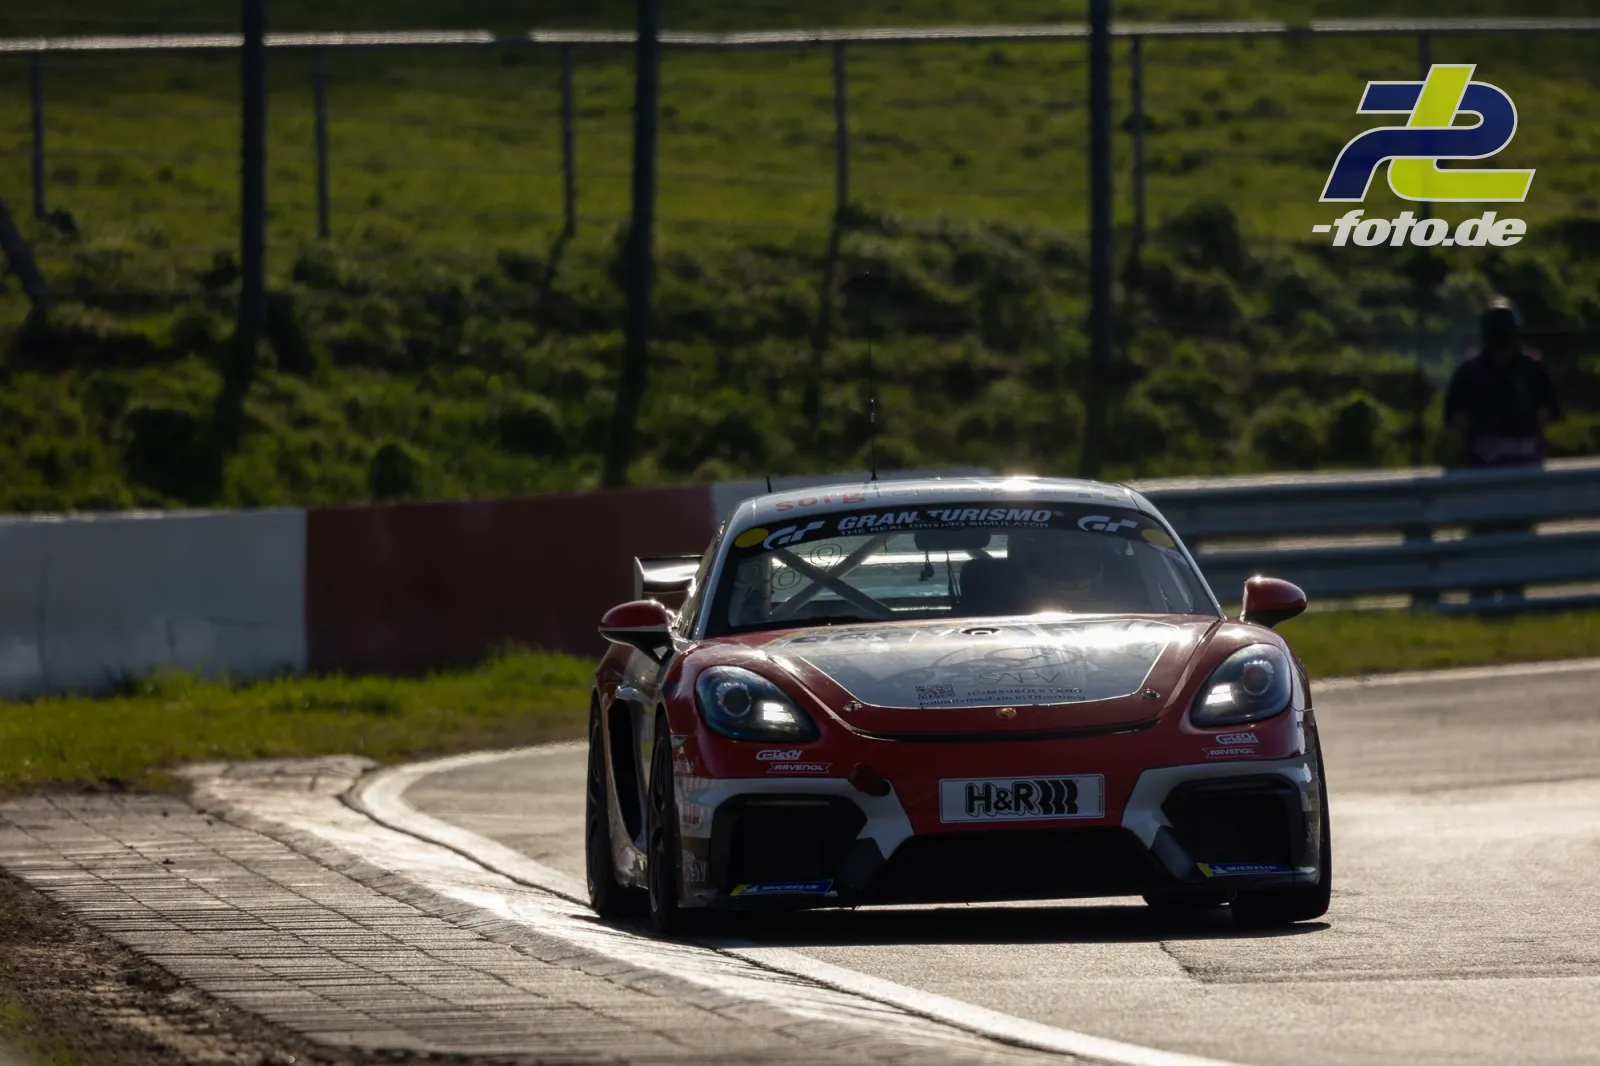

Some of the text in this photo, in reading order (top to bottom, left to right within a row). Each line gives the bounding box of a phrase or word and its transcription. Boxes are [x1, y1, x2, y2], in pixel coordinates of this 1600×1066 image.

[837, 508, 1053, 531] GRAN TURISMO
[869, 525, 905, 533] REAL
[968, 520, 1049, 528] SIMULATOR
[1208, 747, 1256, 757] RAVENOL
[774, 764, 825, 772] RAVENOL
[965, 780, 1041, 818] H&R
